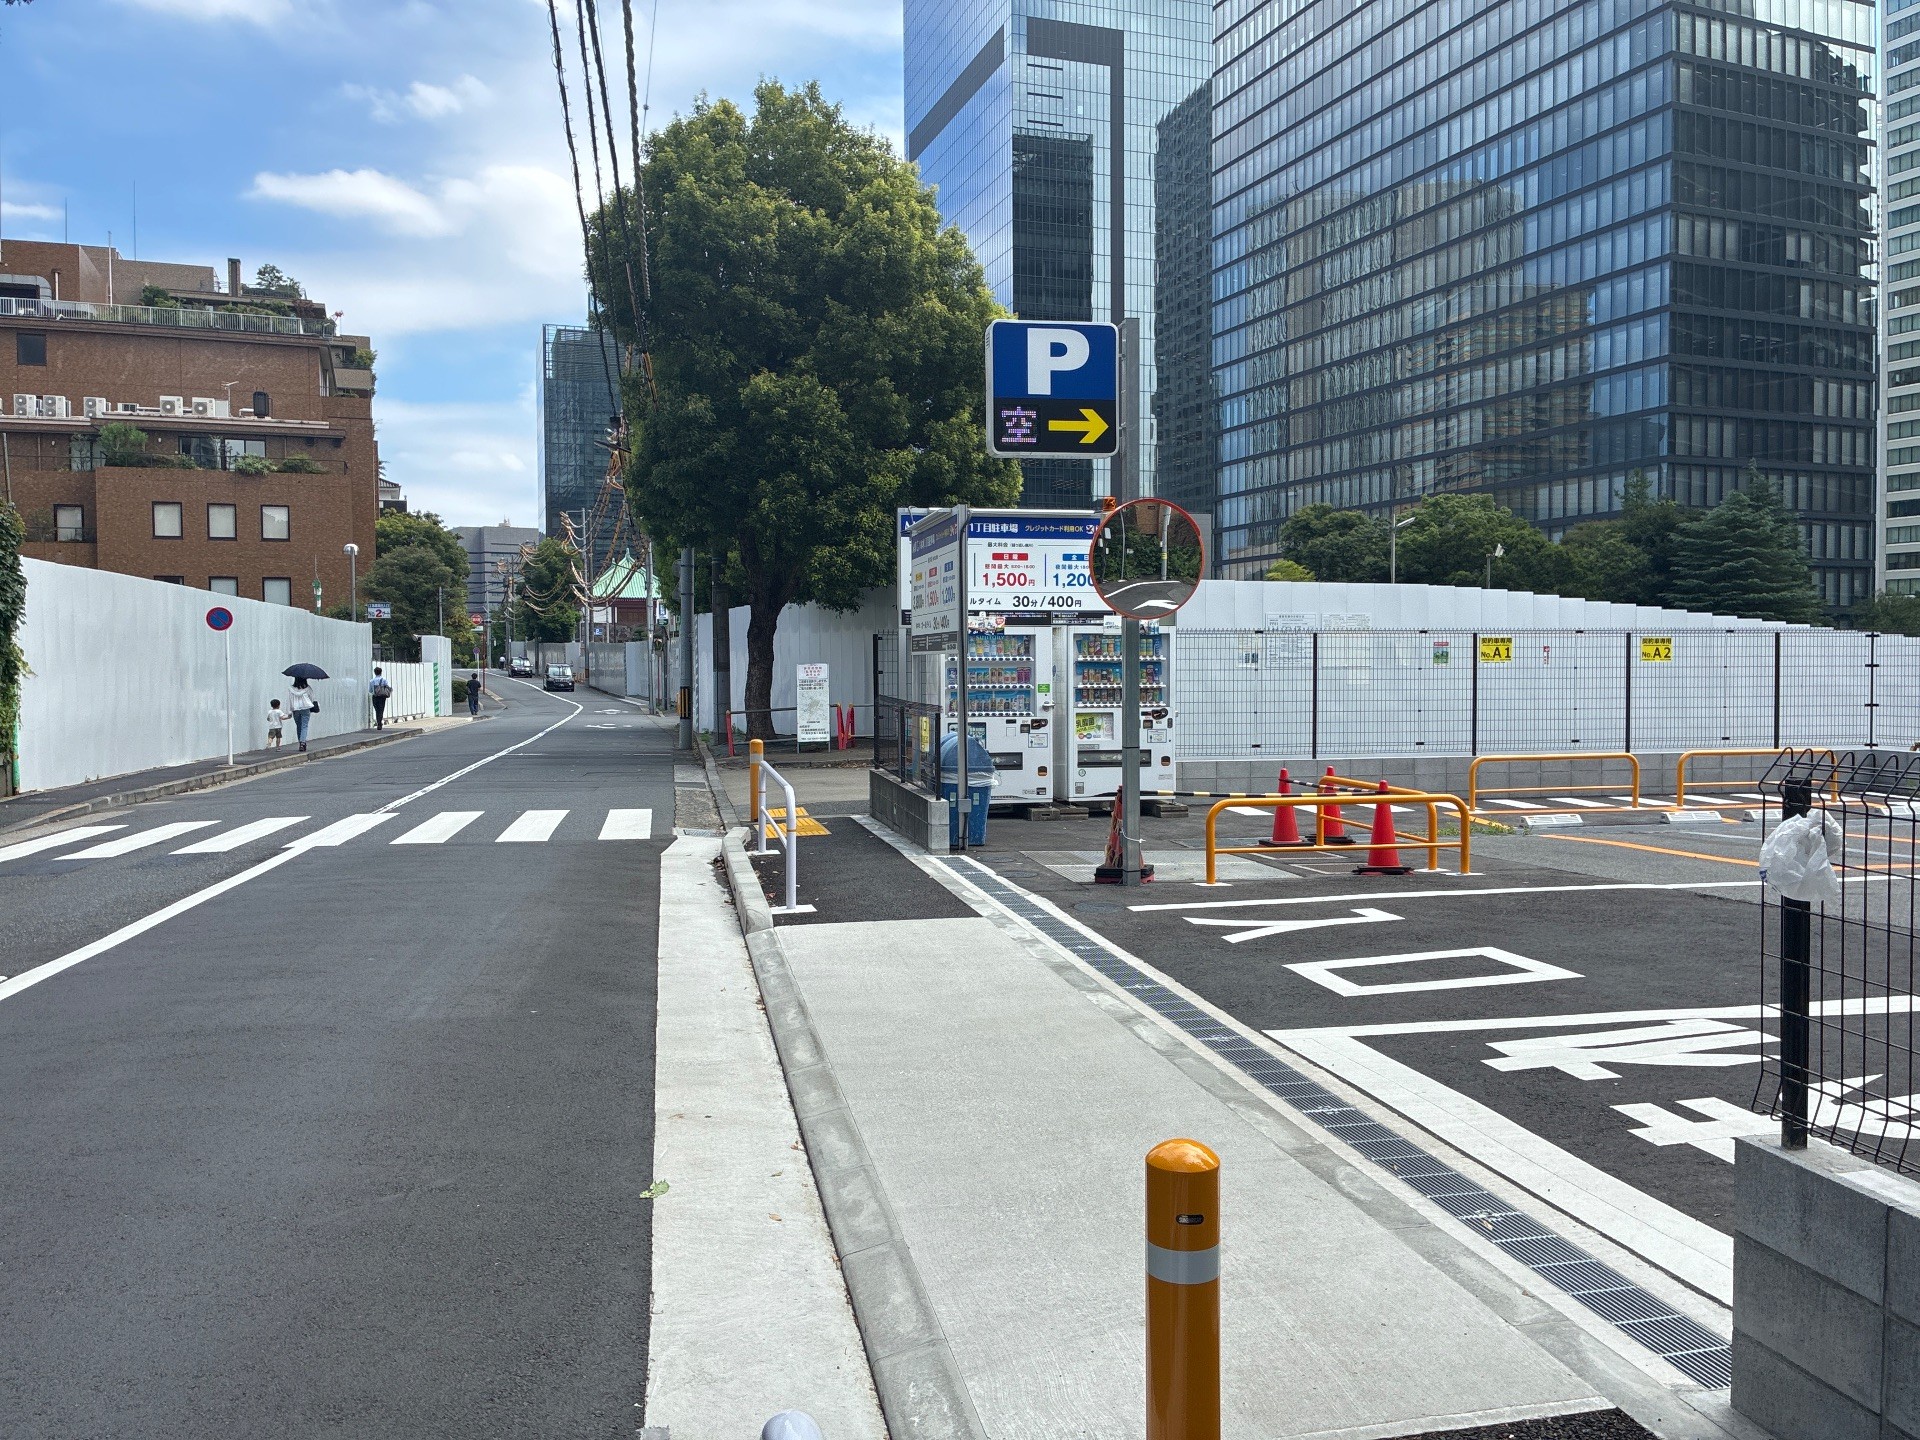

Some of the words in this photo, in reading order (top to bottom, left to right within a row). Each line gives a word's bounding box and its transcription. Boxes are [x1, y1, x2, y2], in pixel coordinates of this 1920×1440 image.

[1027, 327, 1090, 395] P
[1001, 406, 1037, 443] 空
[982, 572, 1036, 588] 1,500円
[1012, 595, 1039, 608] 30分
[1047, 595, 1082, 608] 400円
